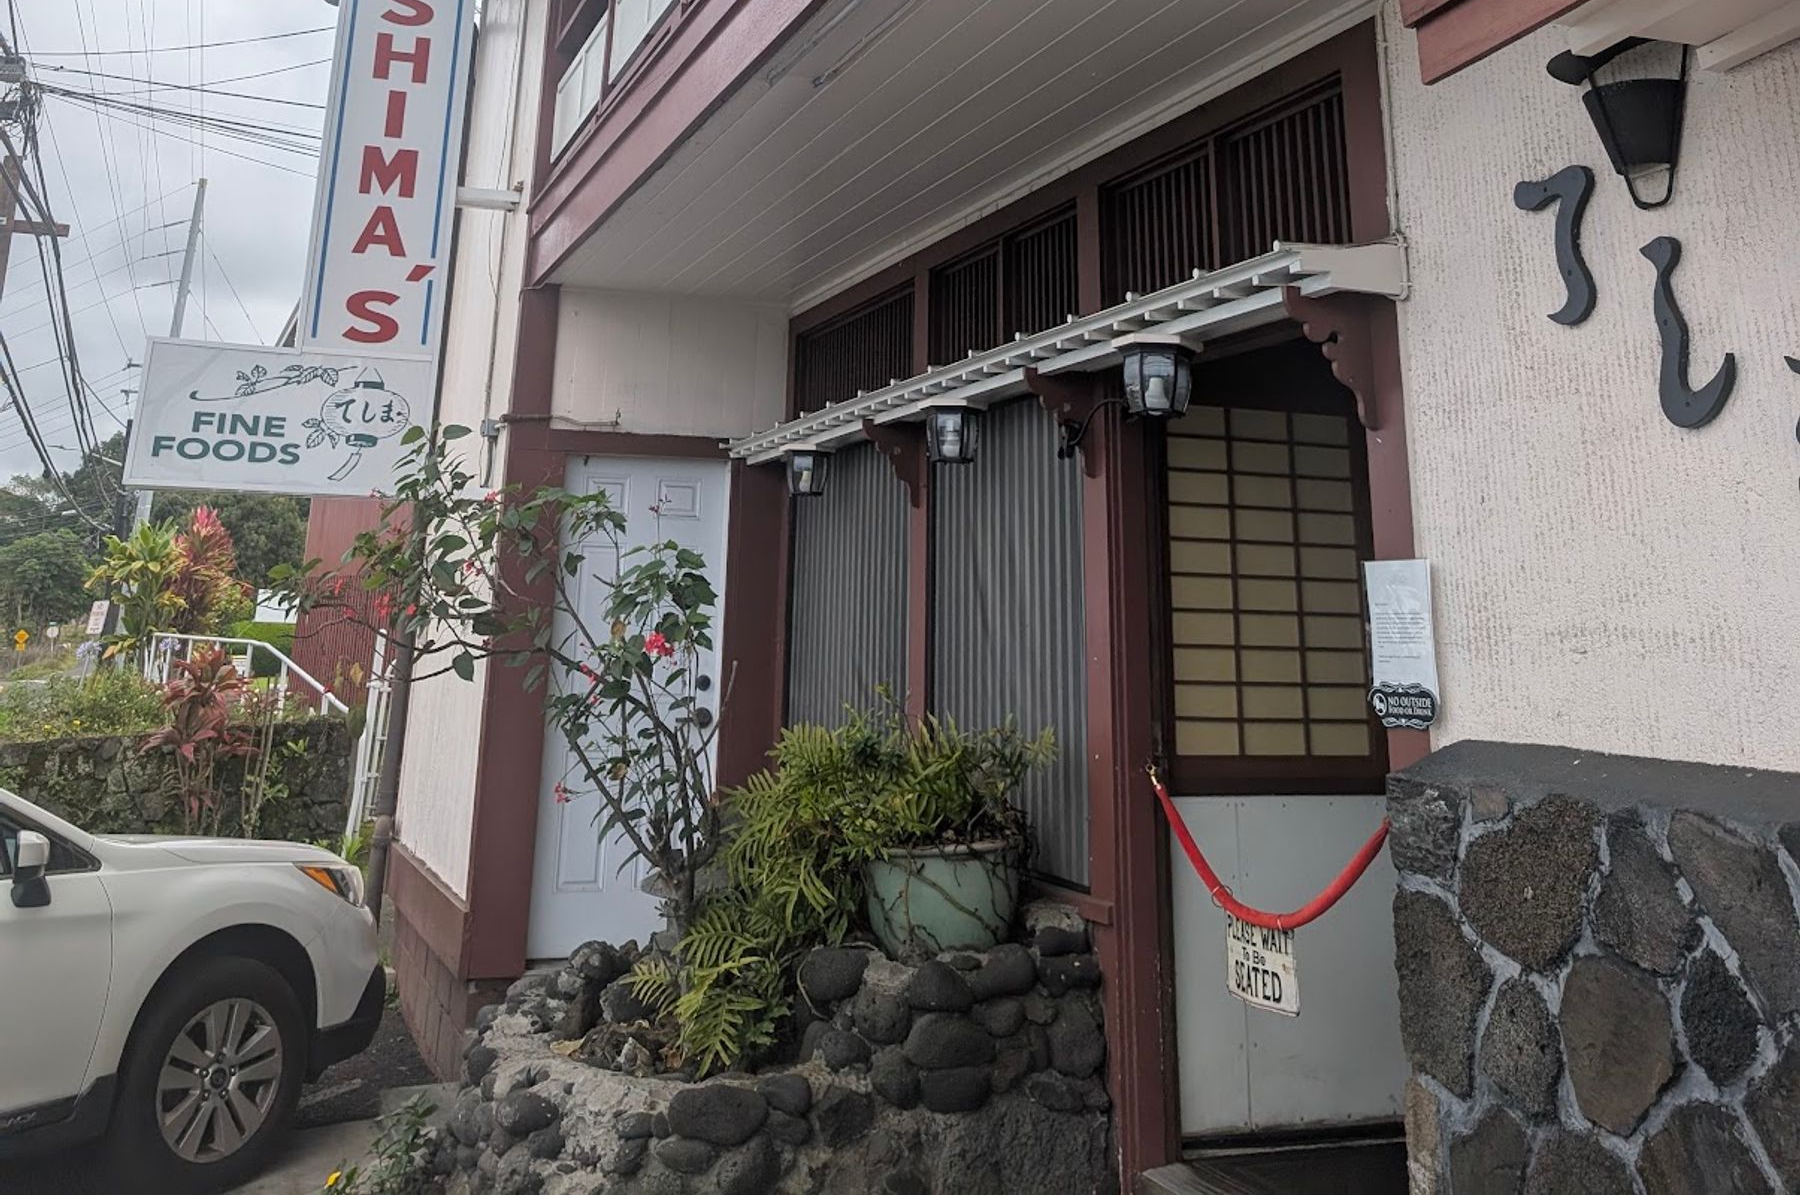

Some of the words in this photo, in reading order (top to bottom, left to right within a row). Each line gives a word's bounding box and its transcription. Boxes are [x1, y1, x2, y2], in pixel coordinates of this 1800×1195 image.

[1513, 165, 1800, 495] てし
[191, 411, 287, 438] FINE
[335, 399, 403, 424] てしま
[151, 435, 301, 465] FOODS
[1387, 696, 1399, 706] NO
[1400, 696, 1432, 708] OUTSIDE
[1260, 928, 1289, 955] WAIT
[1235, 959, 1282, 1003] SEATED
